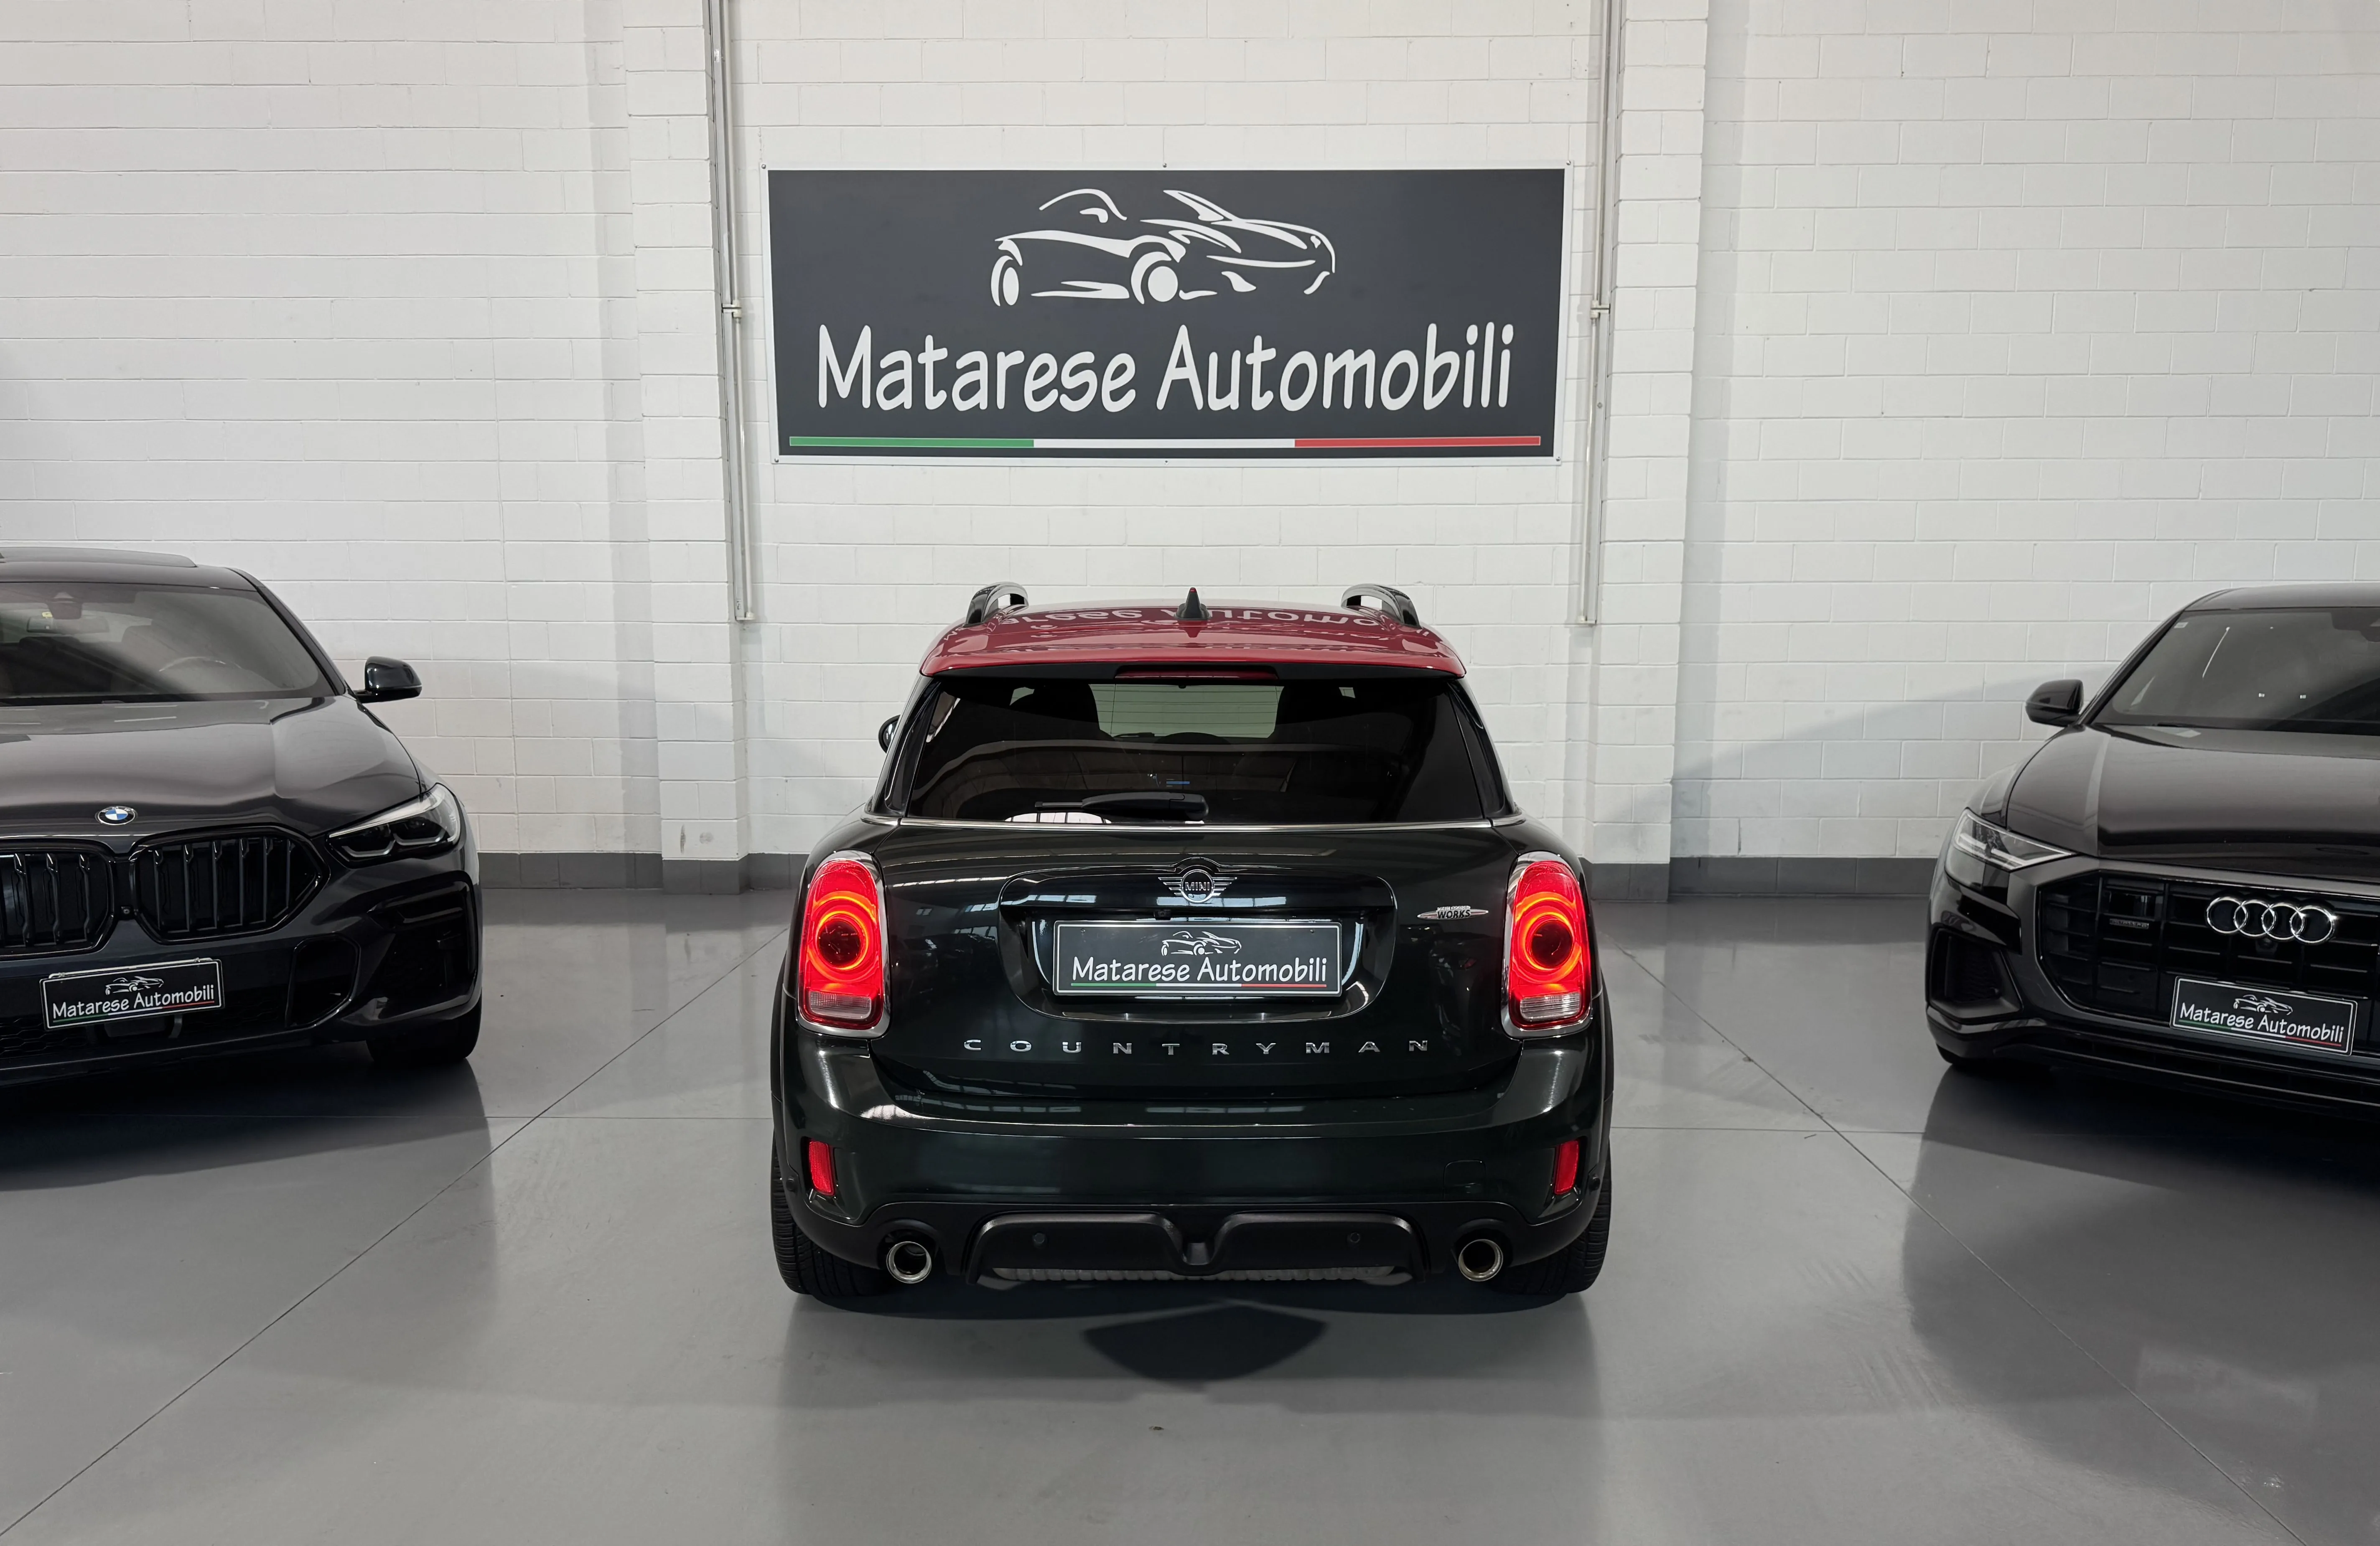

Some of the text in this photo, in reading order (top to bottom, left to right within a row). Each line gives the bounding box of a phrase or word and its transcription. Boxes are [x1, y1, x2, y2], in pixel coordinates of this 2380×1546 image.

[818, 321, 1514, 413] Matarese Automobili
[1185, 881, 1210, 891] MINI
[1438, 909, 1471, 919] WORKS
[1072, 956, 1327, 982] Matarese Automobili
[53, 984, 214, 1019] Matarese Automobili
[2180, 1002, 2344, 1043] Matarese Automobili
[963, 1039, 1428, 1055] COUNTRYMAN
